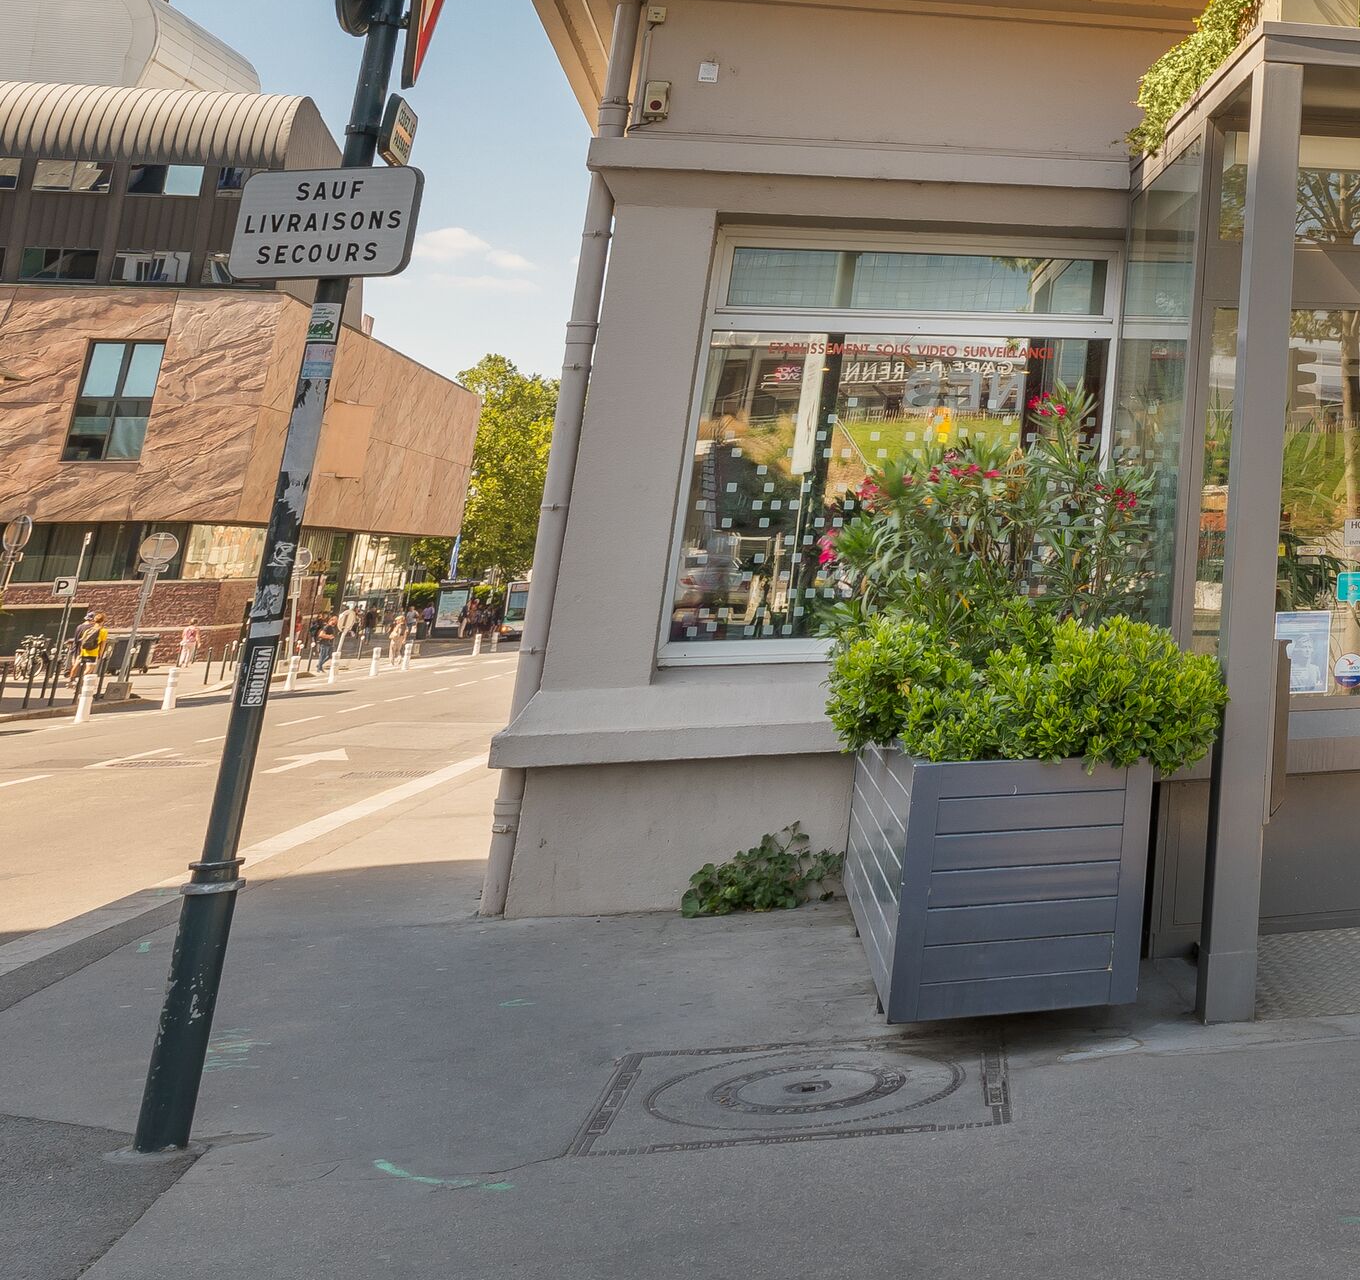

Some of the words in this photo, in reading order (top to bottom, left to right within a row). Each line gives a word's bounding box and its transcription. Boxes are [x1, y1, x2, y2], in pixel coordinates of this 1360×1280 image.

[296, 180, 364, 201] SAUF
[244, 210, 402, 234] LIVRAISONS
[256, 242, 378, 265] SECOURS
[768, 342, 870, 356] ETABLISSEMENT
[876, 344, 911, 357] SOUS
[917, 345, 957, 358] VIDEO
[963, 346, 1055, 360] SURVEILLANCE
[56, 580, 69, 594] P
[246, 648, 272, 705] VISITORS
